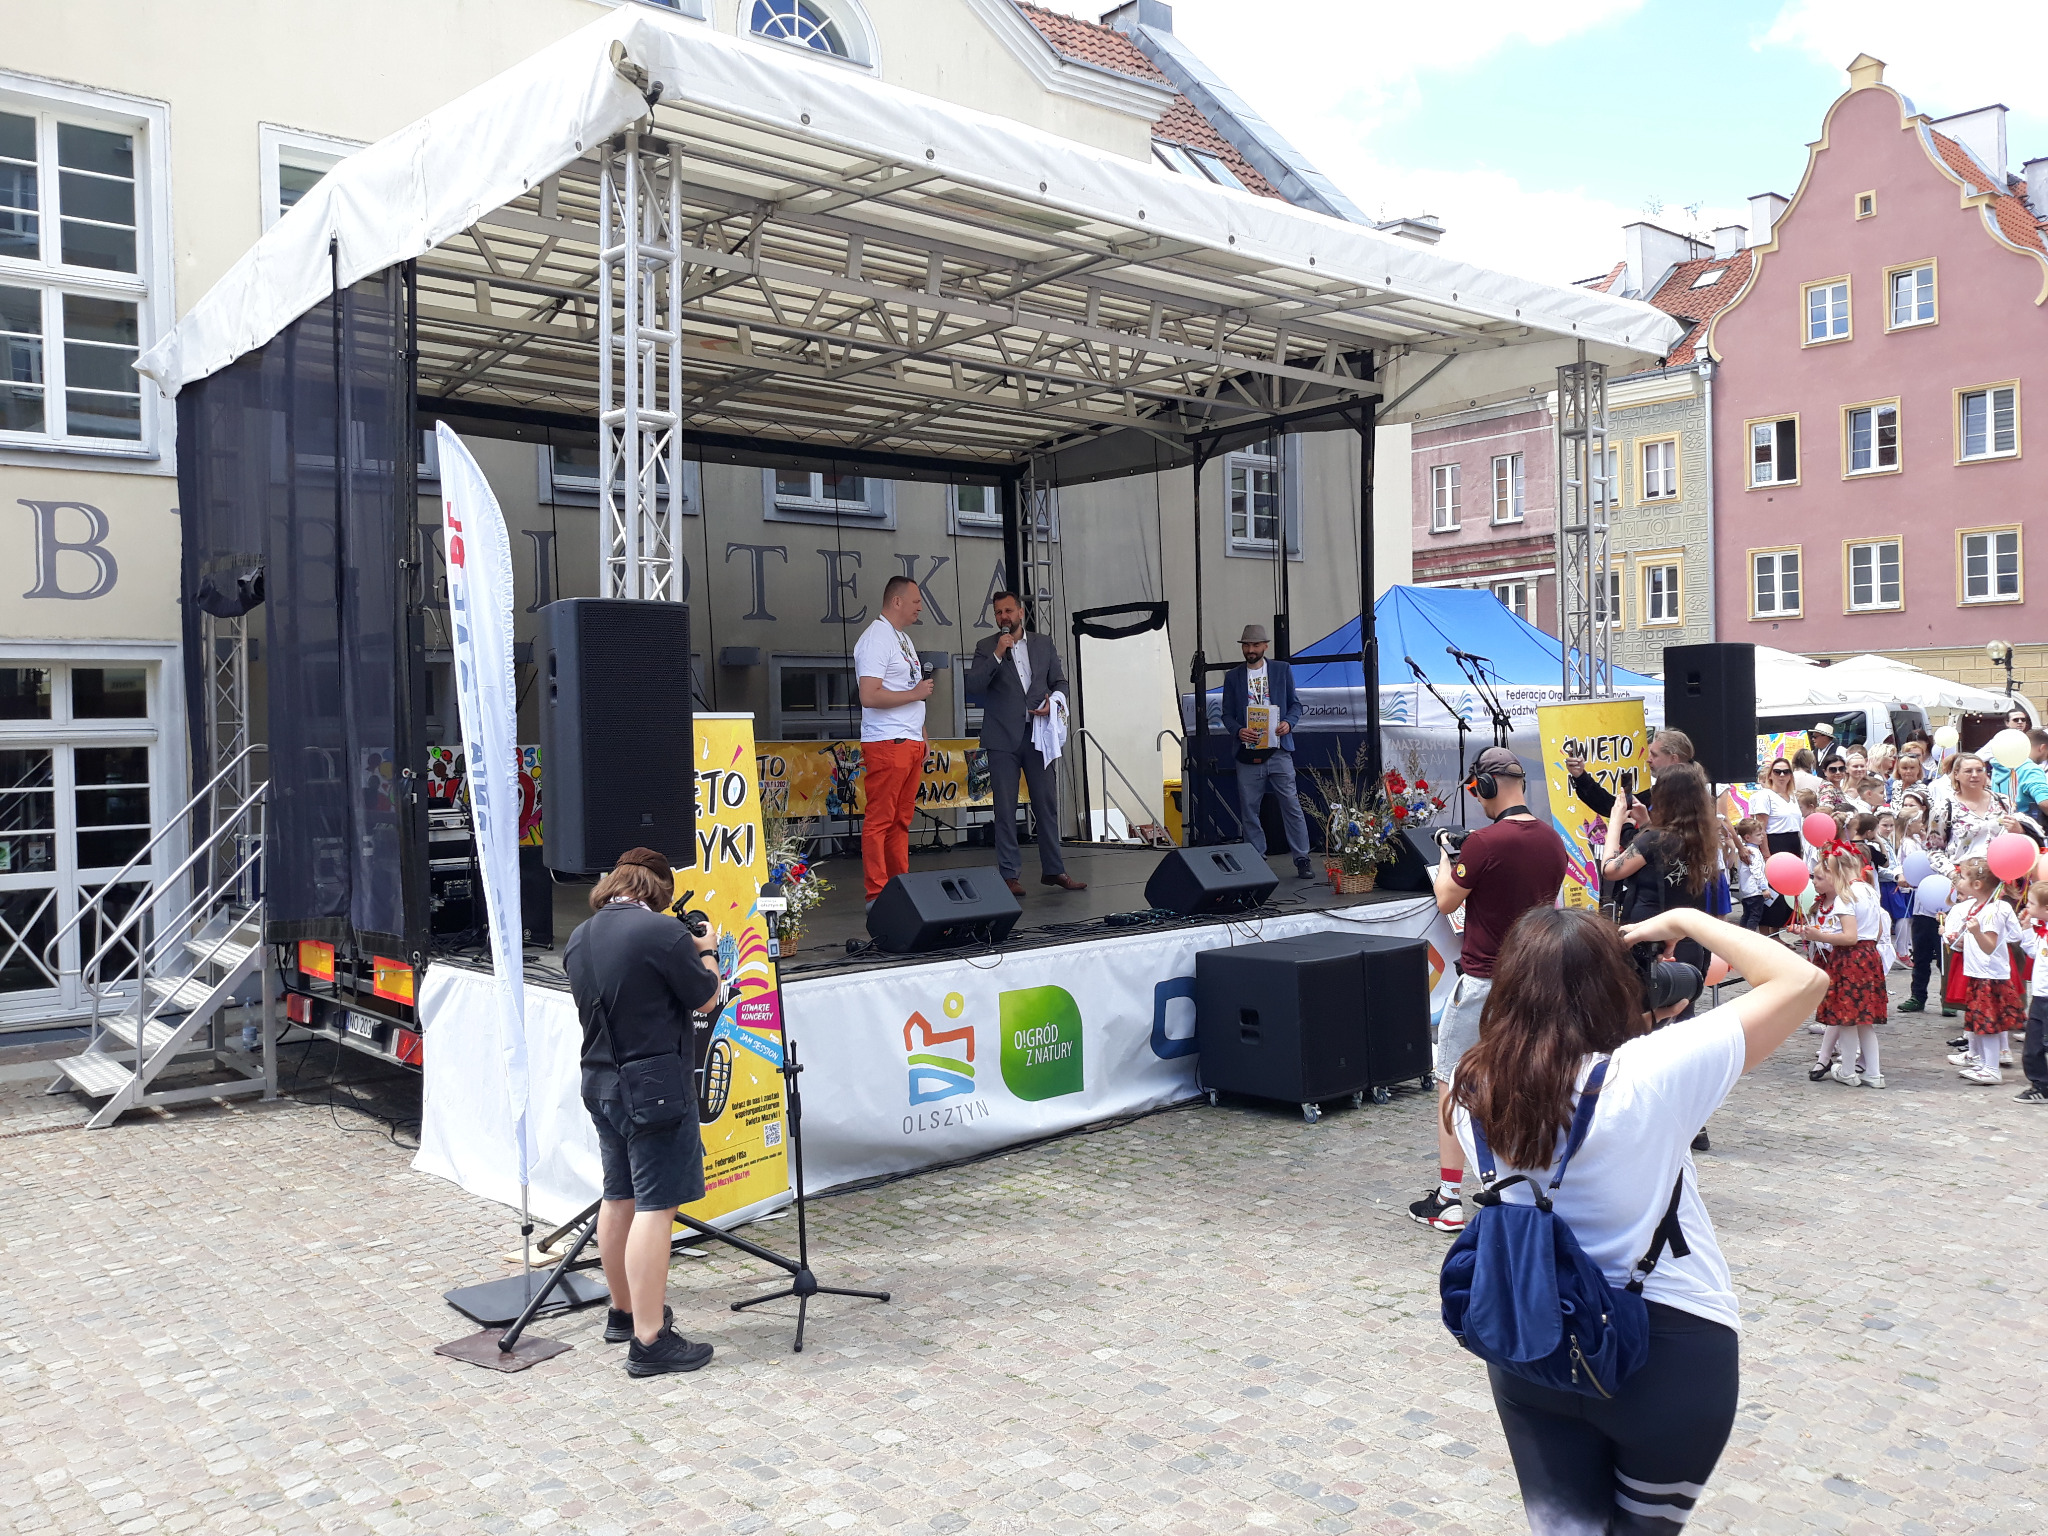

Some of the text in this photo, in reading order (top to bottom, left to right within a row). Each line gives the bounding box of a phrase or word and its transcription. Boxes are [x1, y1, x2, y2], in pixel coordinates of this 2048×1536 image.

[1506, 689, 1546, 701] Federacja
[1567, 766, 1640, 797] MZYI
[741, 1003, 770, 1013] OTWARTE
[741, 1012, 774, 1021] KONCERTY
[740, 1033, 780, 1060] JAM SESSION
[1014, 1022, 1059, 1050] O!GRÓD
[1026, 1041, 1073, 1067] Z NATURY
[903, 1099, 990, 1135] OLSZTYN
